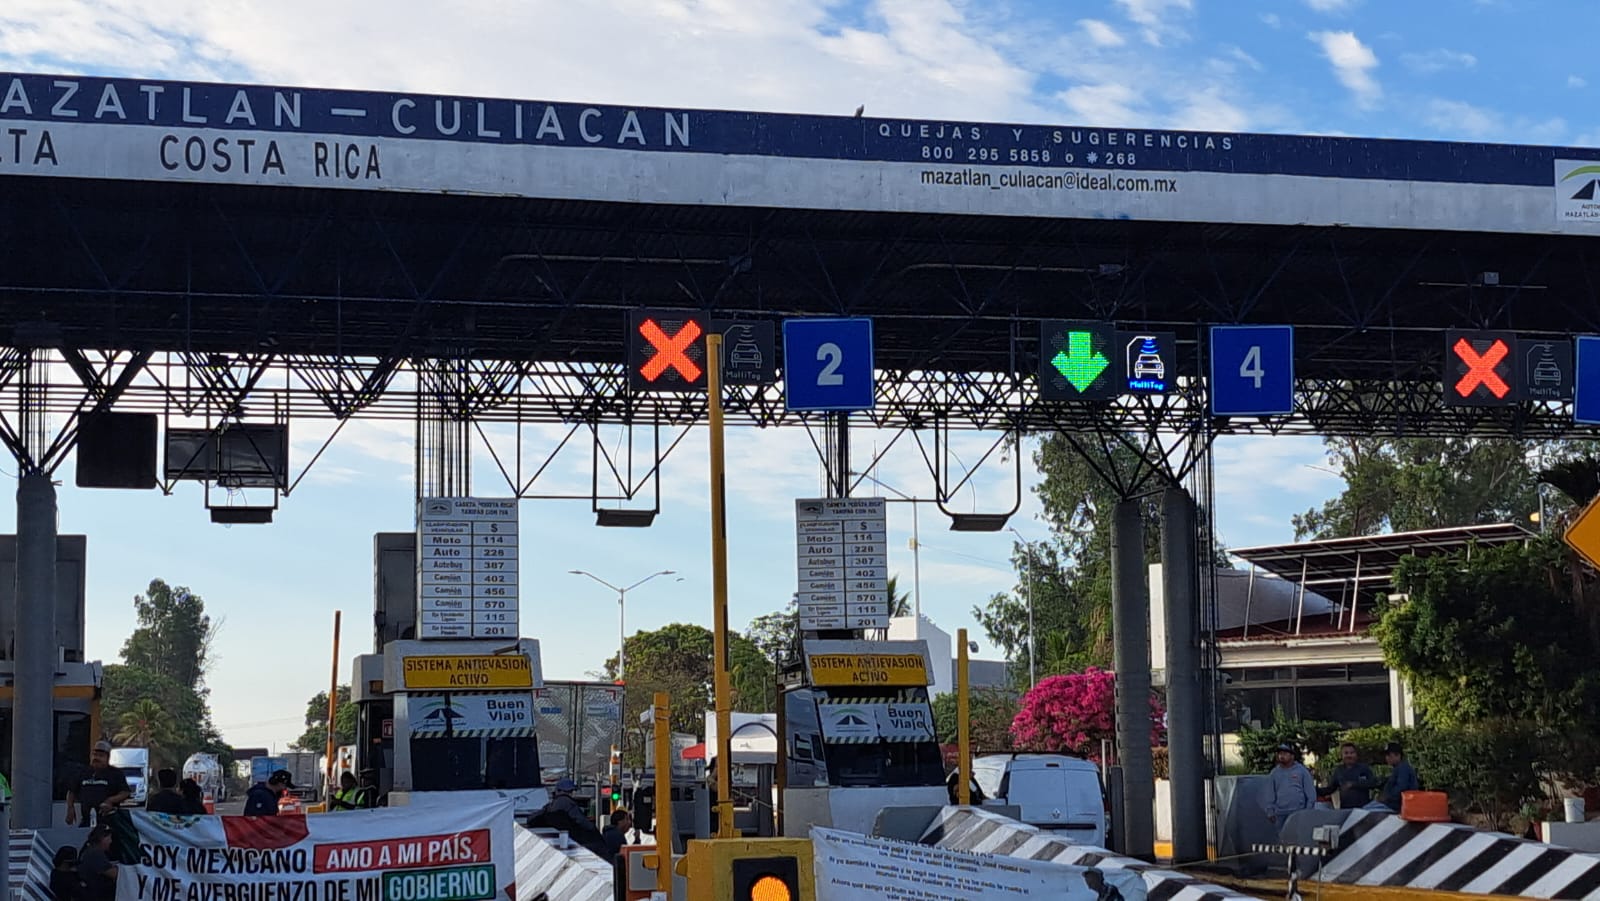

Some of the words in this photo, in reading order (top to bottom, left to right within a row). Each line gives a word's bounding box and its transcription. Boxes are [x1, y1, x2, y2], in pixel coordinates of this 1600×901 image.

[391, 98, 690, 148] CULIACAN
[879, 123, 981, 140] QUEJAS
[1012, 128, 1023, 141] Y
[1053, 130, 1233, 150] SUGERENCIAS
[0, 128, 58, 166] TA
[160, 134, 286, 176] COSTA
[314, 141, 381, 179] RICA
[921, 145, 954, 159] 800
[967, 147, 999, 160] 295
[1009, 149, 1051, 162] 5858
[920, 168, 1178, 194] mazatlan_culiacan@ideal.com.mx
[816, 342, 844, 386] 2
[1239, 345, 1265, 389] 4
[1129, 380, 1164, 391] MultiTag
[432, 536, 462, 544] Moto
[434, 548, 460, 556] Auto
[808, 546, 833, 554] Auto
[484, 575, 504, 583] 402
[485, 613, 505, 621] 115
[406, 660, 452, 671] SISTEMA
[811, 659, 853, 669] SISTEMA
[450, 674, 489, 685] ACTIVO
[852, 671, 888, 682] ACTIVO
[487, 700, 525, 710] Buen
[489, 710, 525, 723] Viaje
[888, 708, 923, 719] Buen
[891, 719, 925, 730] Viaje
[140, 844, 180, 871] SOY
[187, 848, 307, 874] MEXICANO
[326, 845, 372, 870] AMO
[378, 845, 391, 866] A
[398, 842, 422, 864] MI
[428, 832, 478, 862] PAÍS,
[137, 872, 148, 900] Y
[152, 877, 182, 901] ME
[324, 878, 348, 901] DE
[356, 878, 380, 901] MI
[388, 870, 490, 900] GOBIERNO
